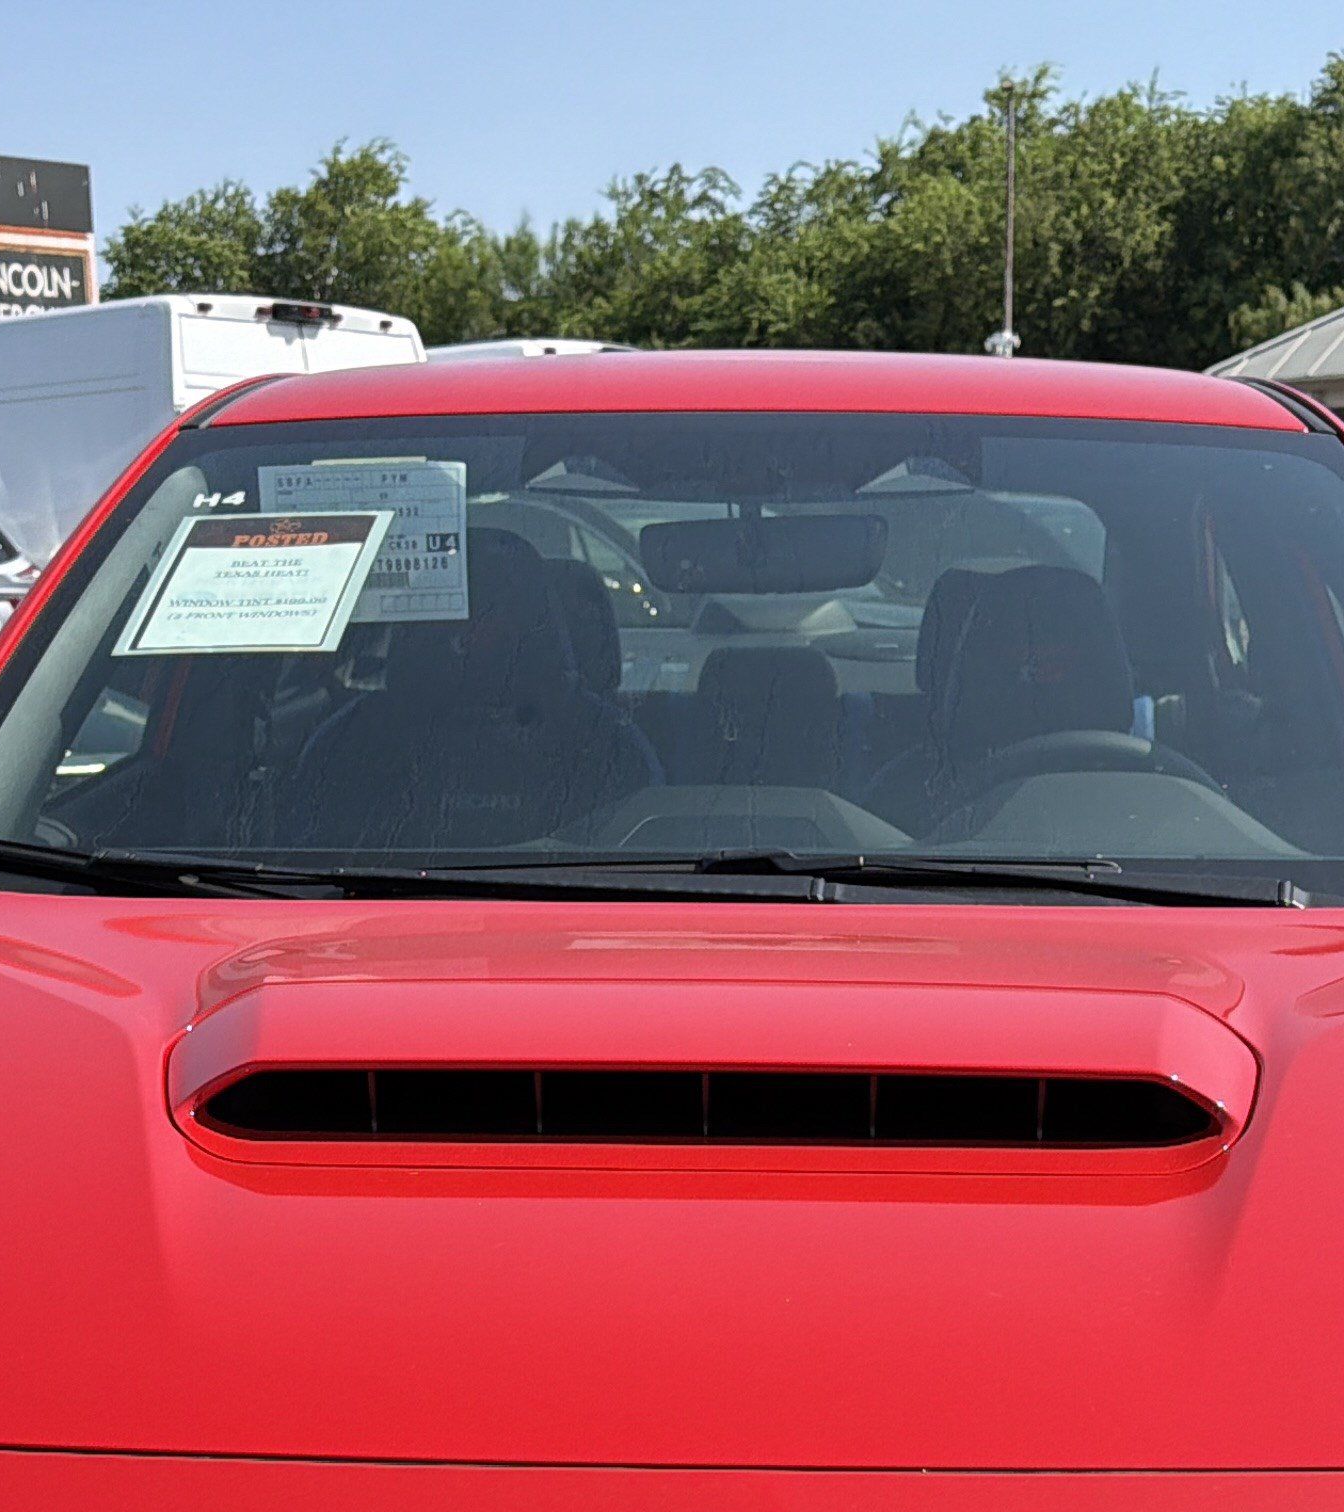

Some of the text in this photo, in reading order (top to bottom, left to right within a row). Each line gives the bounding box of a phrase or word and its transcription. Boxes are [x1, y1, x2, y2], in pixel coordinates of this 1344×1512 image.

[231, 532, 329, 547] POSTED
[230, 558, 304, 568] BEAT THE
[213, 569, 261, 579] TEXAS
[168, 598, 233, 608] WINDOW
[237, 597, 272, 607] TINT
[185, 611, 235, 620] FRONT
